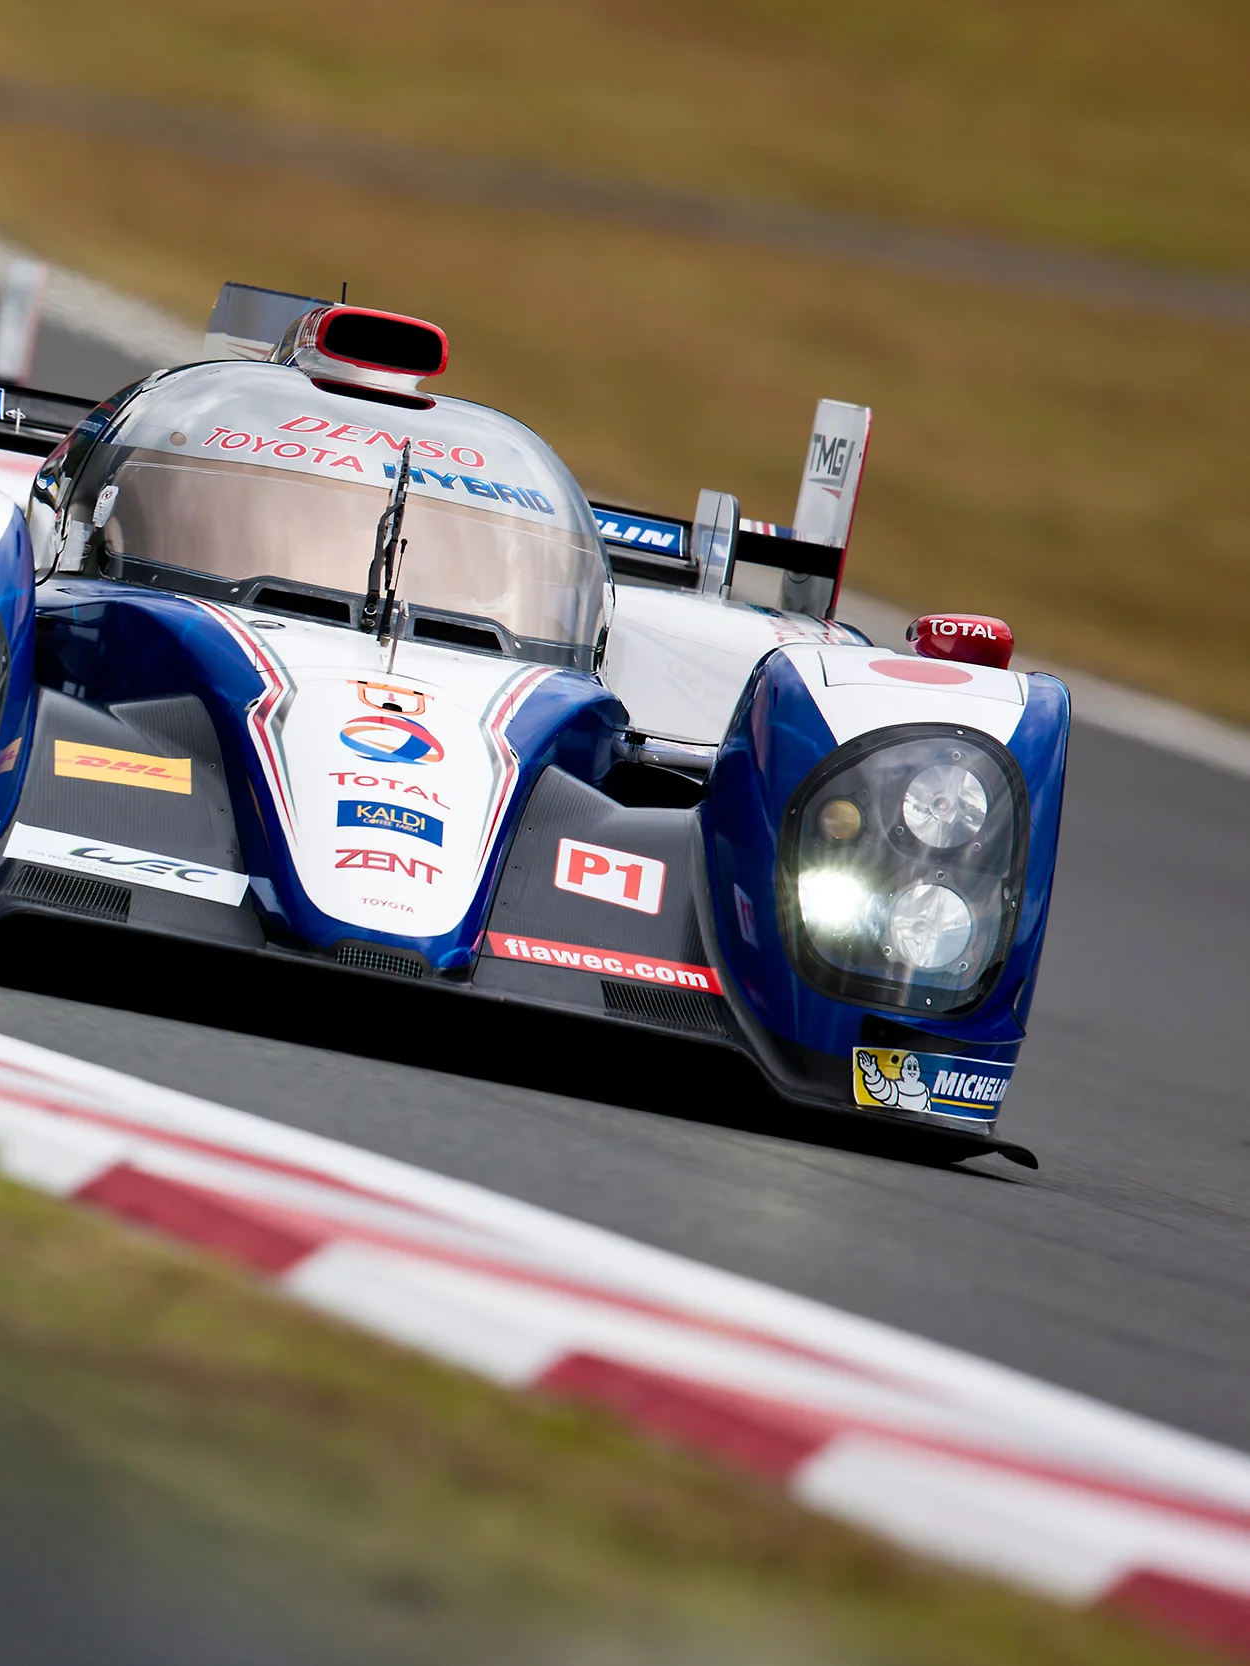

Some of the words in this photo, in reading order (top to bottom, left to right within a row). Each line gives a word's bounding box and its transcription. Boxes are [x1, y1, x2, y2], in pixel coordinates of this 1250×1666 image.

[277, 415, 487, 470] DENSO
[809, 432, 848, 477] TMG
[201, 426, 365, 474] TOYOTA
[382, 461, 556, 516] HYBRID
[929, 619, 997, 640] TOTAL
[75, 755, 174, 779] DHL
[329, 772, 451, 811] TOTAL
[356, 804, 426, 831] KALDI
[69, 847, 218, 883] WEC
[335, 848, 443, 885] ZENT
[566, 848, 643, 901] P1
[361, 897, 415, 914] TOYOTA
[504, 938, 709, 989] fiawec.com
